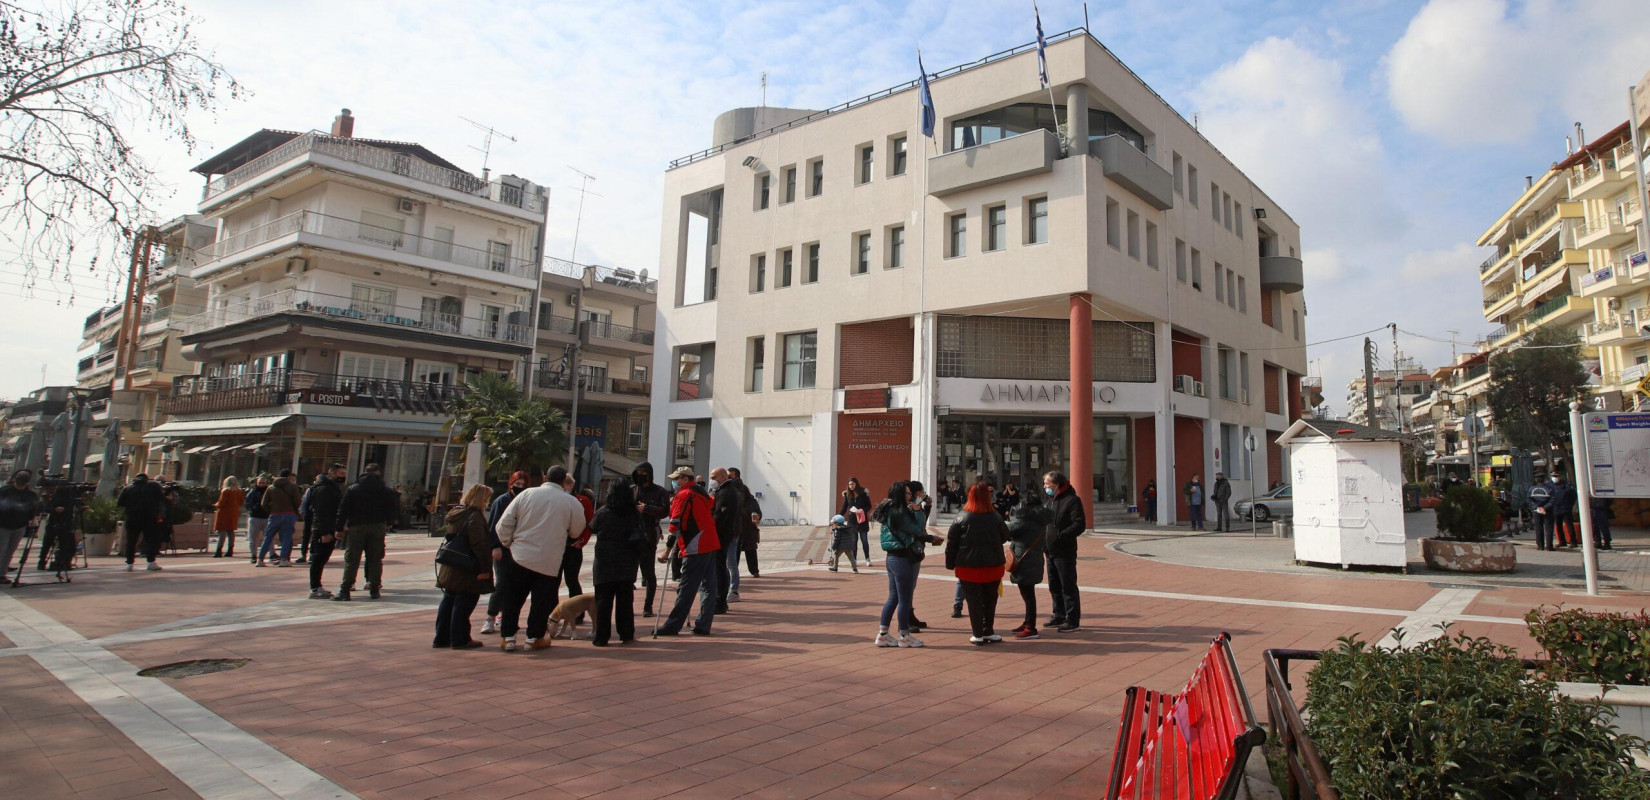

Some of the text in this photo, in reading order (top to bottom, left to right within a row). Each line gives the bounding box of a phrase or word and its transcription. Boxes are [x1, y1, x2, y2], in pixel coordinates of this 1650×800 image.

[980, 383, 1116, 403] ΔΗΜΑΡΙΟ
[310, 394, 317, 403] IL
[318, 394, 343, 405] POSTO
[1594, 396, 1606, 409] 21
[852, 419, 904, 427] ΔΗΜΑΡΧΕΙΟ
